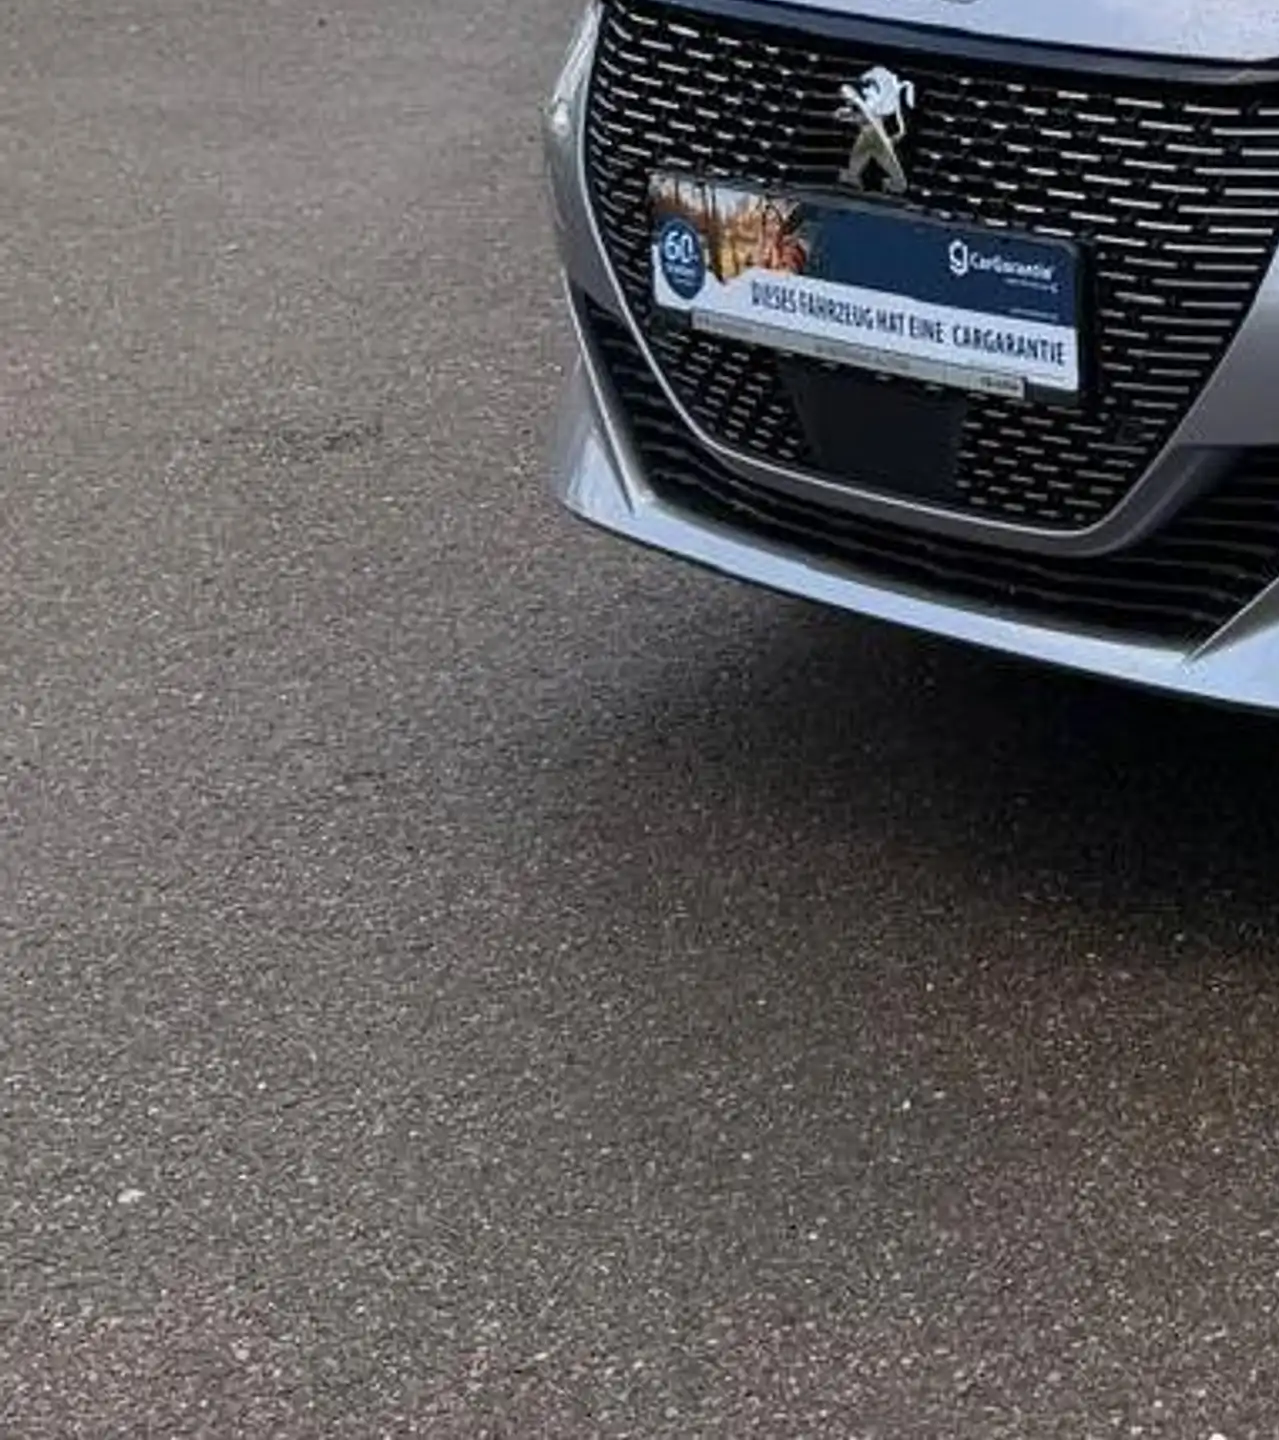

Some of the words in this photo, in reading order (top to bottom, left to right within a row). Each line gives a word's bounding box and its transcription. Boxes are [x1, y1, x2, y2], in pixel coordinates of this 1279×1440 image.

[751, 279, 797, 314] DIESES
[799, 289, 874, 330] FAHRZEUG
[876, 308, 905, 337] HAT
[909, 314, 945, 344] EINE
[952, 323, 1066, 366] CARGARANTIE
